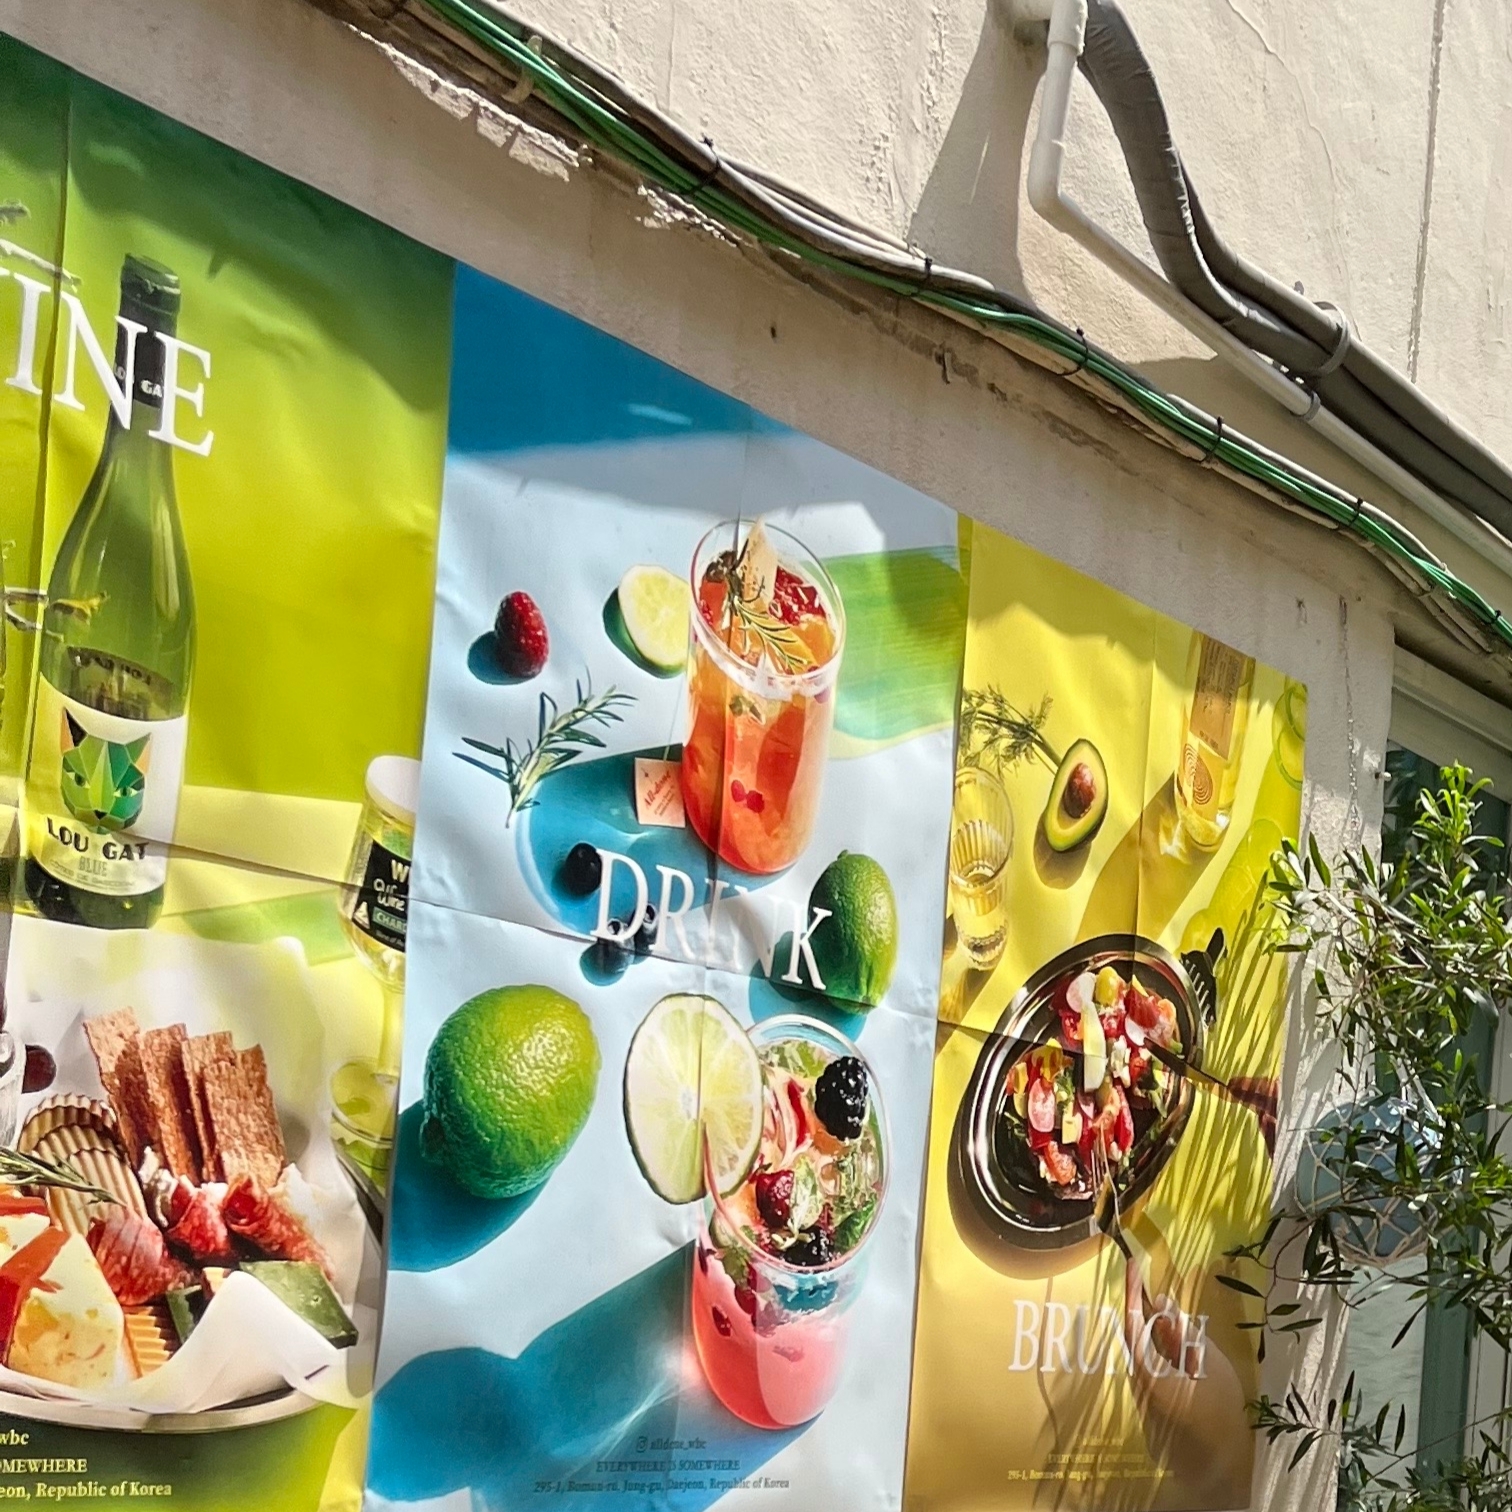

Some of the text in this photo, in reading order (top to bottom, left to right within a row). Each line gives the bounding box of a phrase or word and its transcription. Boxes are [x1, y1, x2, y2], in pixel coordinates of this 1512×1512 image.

[0, 266, 214, 457] INE
[46, 815, 150, 861] LOU GAT
[589, 848, 833, 990] DRINK
[1007, 1298, 1210, 1380] BRUNCH
[0, 1458, 88, 1474] MEWHERE
[678, 1460, 741, 1472] SOMEWHERE
[35, 1480, 107, 1502] Republic
[109, 1481, 128, 1497] of
[129, 1481, 173, 1497] Korea
[709, 1478, 750, 1493] Republic
[752, 1476, 763, 1489] of
[763, 1478, 790, 1489] Korea
